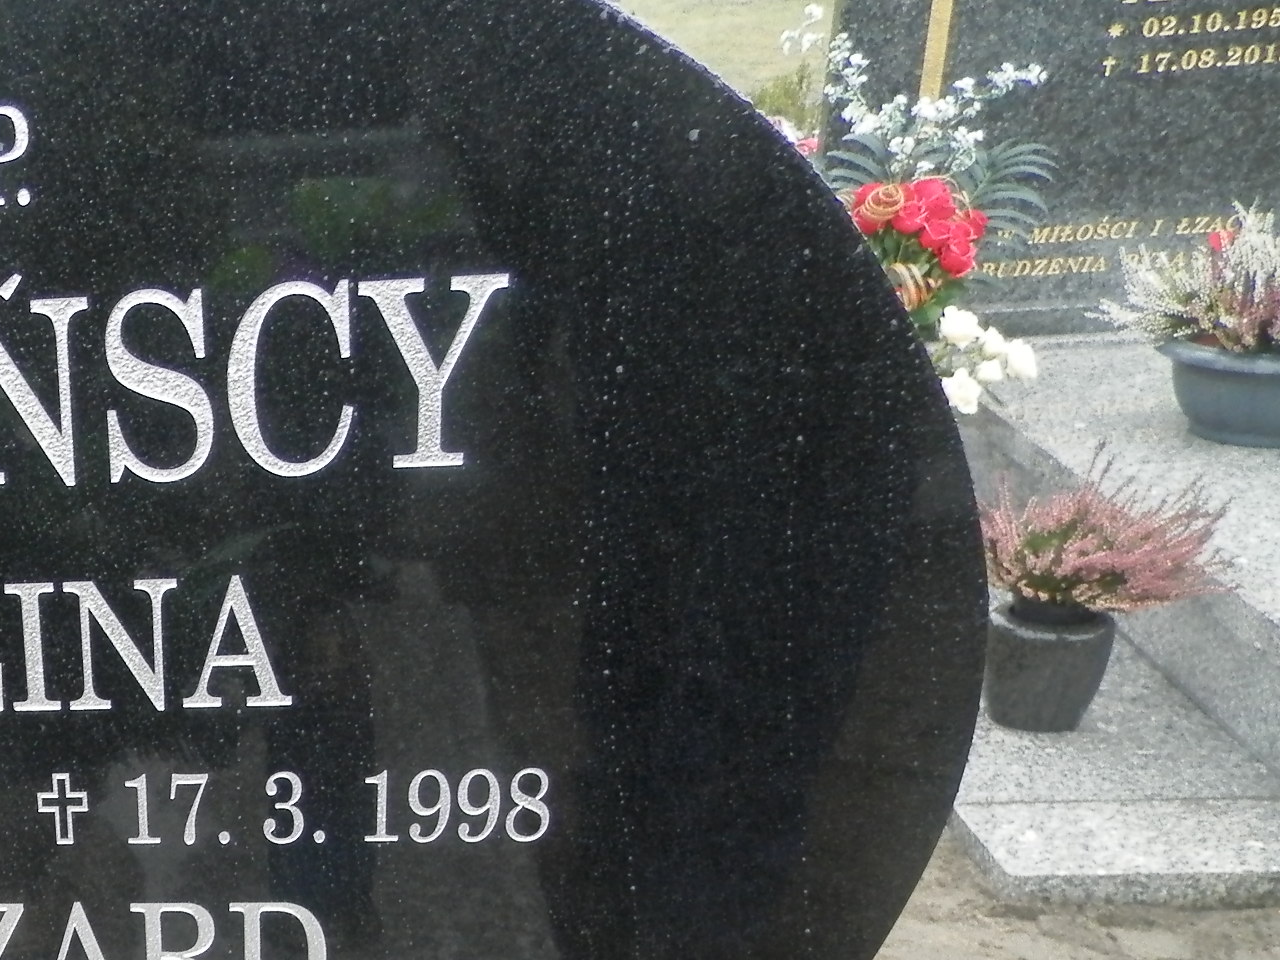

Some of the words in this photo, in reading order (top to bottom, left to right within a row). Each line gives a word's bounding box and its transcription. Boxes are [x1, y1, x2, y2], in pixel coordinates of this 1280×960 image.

[1136, 44, 1280, 74] 17.08.201
[1028, 216, 1138, 244] MIŁOŚCI
[1150, 219, 1164, 237] I
[1176, 212, 1266, 234] ŁZAC
[124, 773, 231, 845] 17.
[262, 771, 326, 845] 3.
[364, 768, 551, 844] 1998
